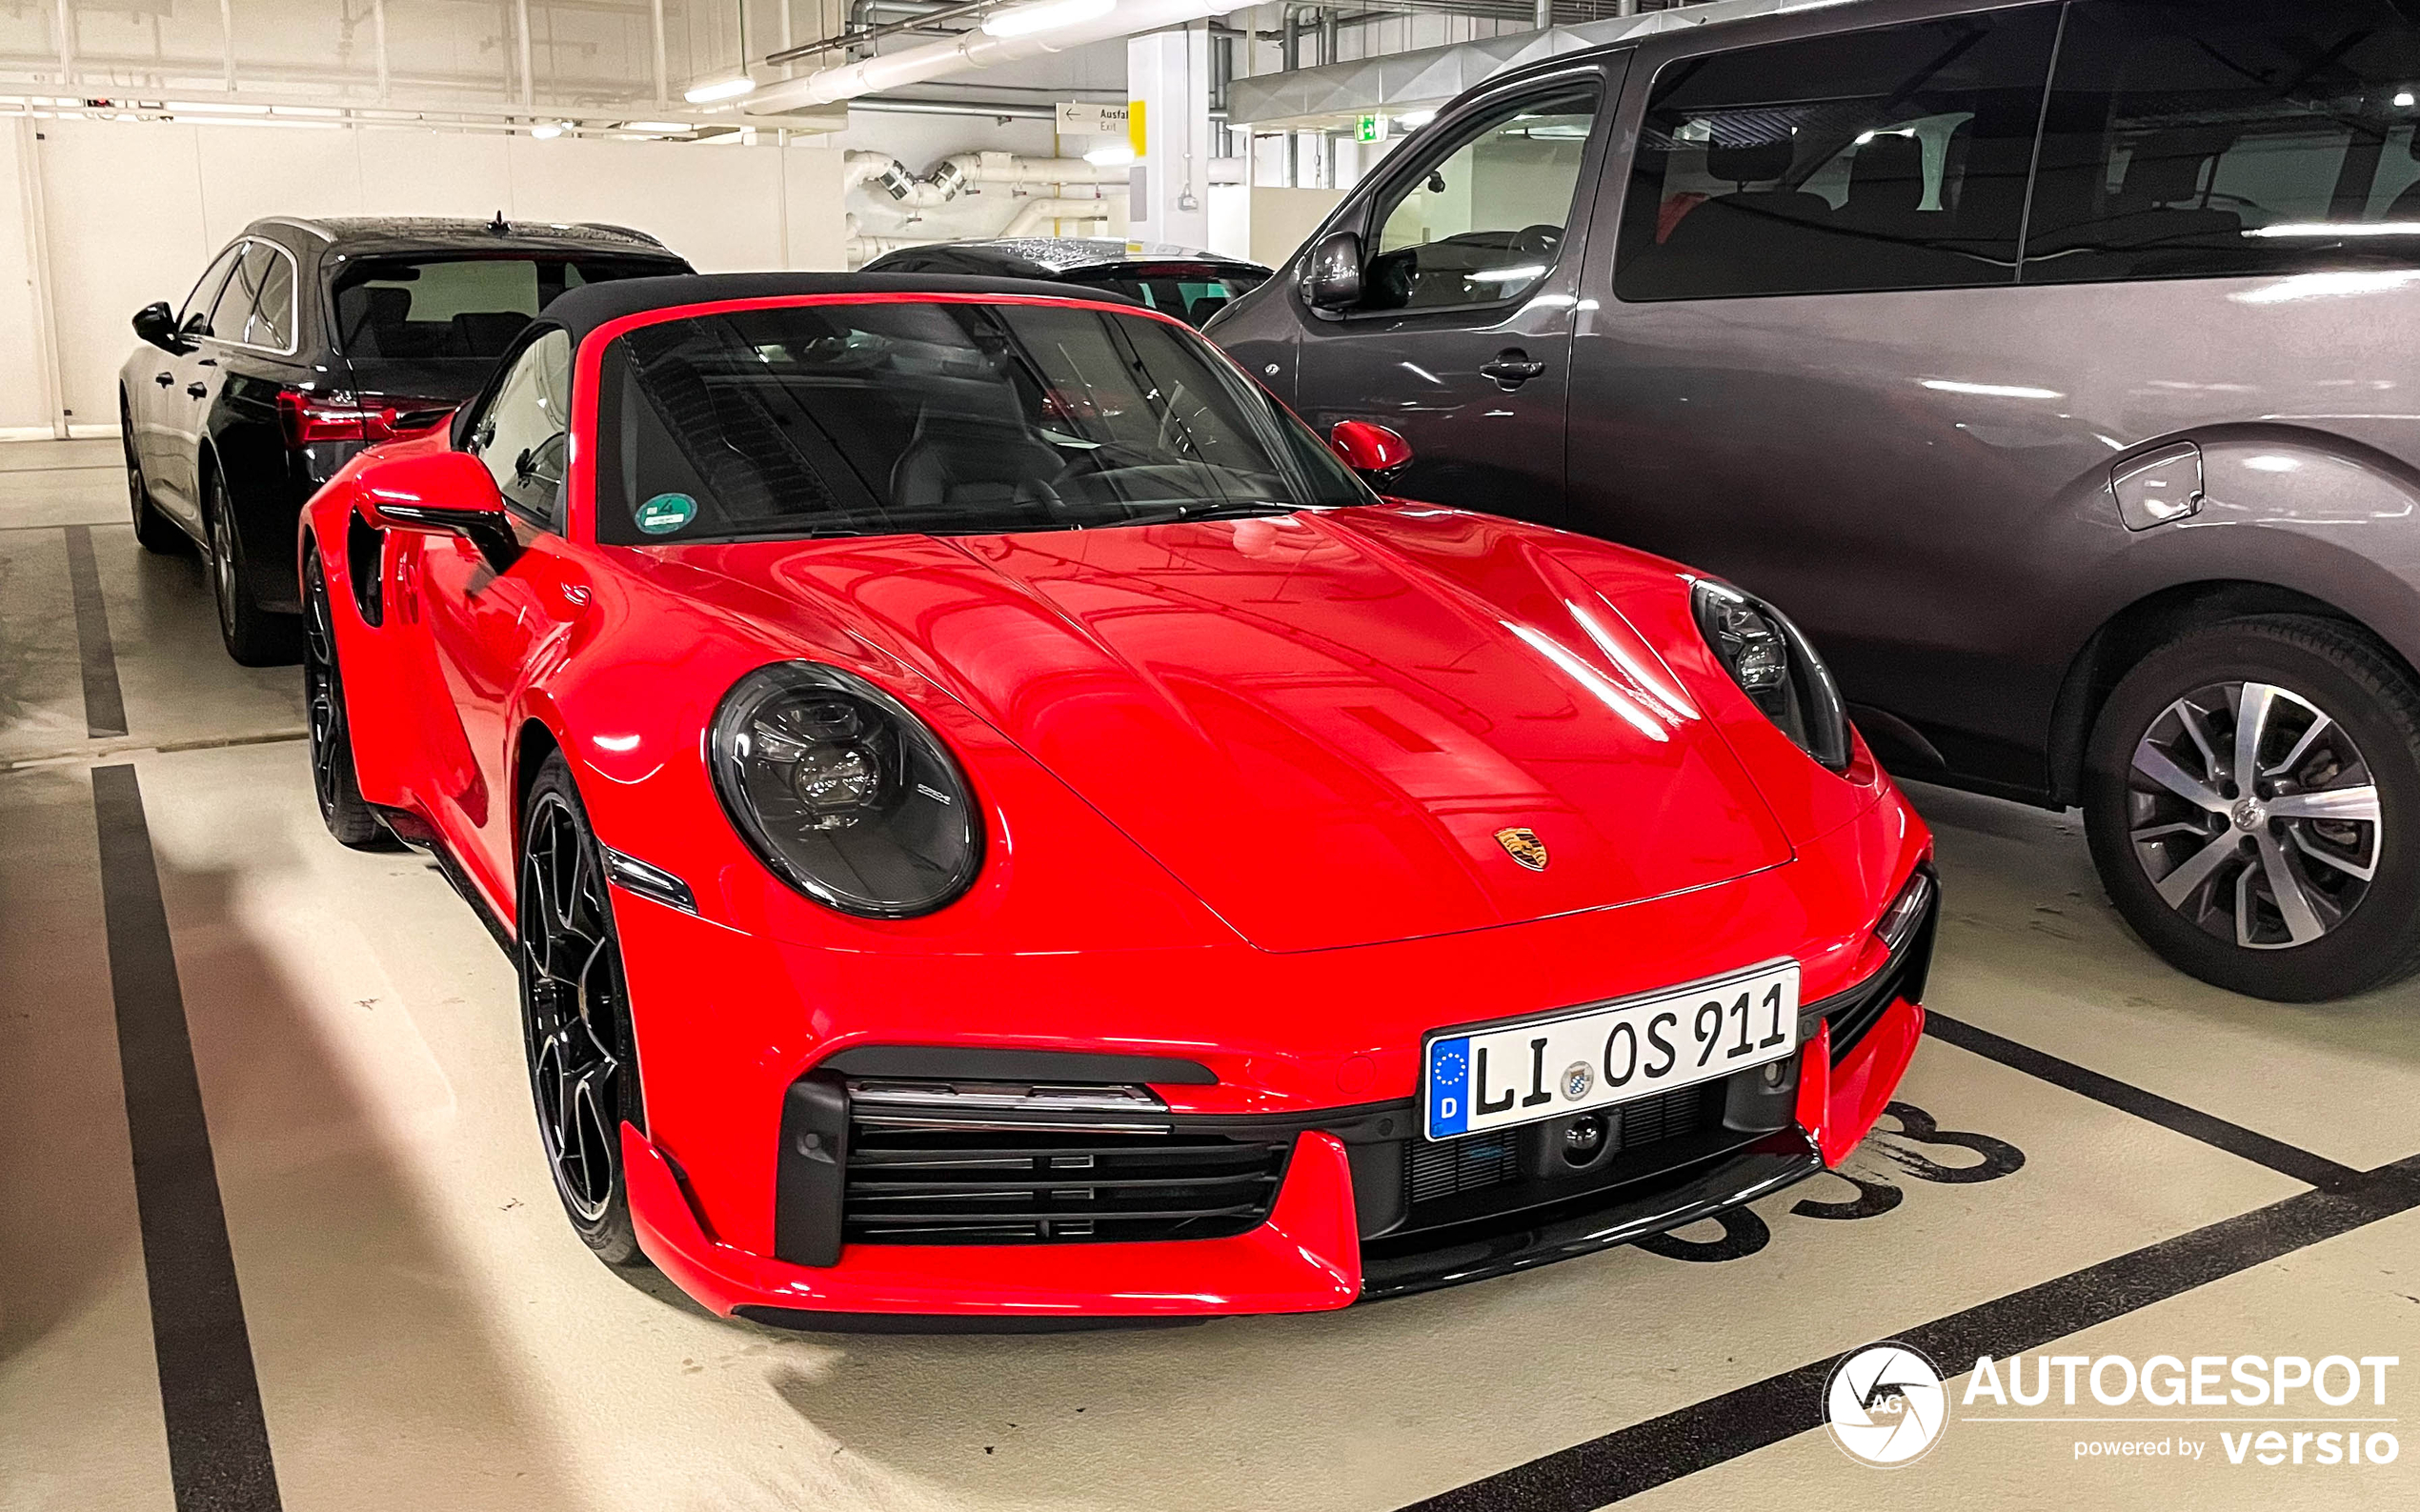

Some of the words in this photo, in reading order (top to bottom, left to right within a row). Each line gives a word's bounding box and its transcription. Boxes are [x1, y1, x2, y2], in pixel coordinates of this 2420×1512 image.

[658, 498, 674, 514] 4
[1477, 1038, 1552, 1116] LI
[1603, 1012, 1677, 1087] OS
[1694, 983, 1785, 1067] 911
[1441, 1098, 1457, 1119] D
